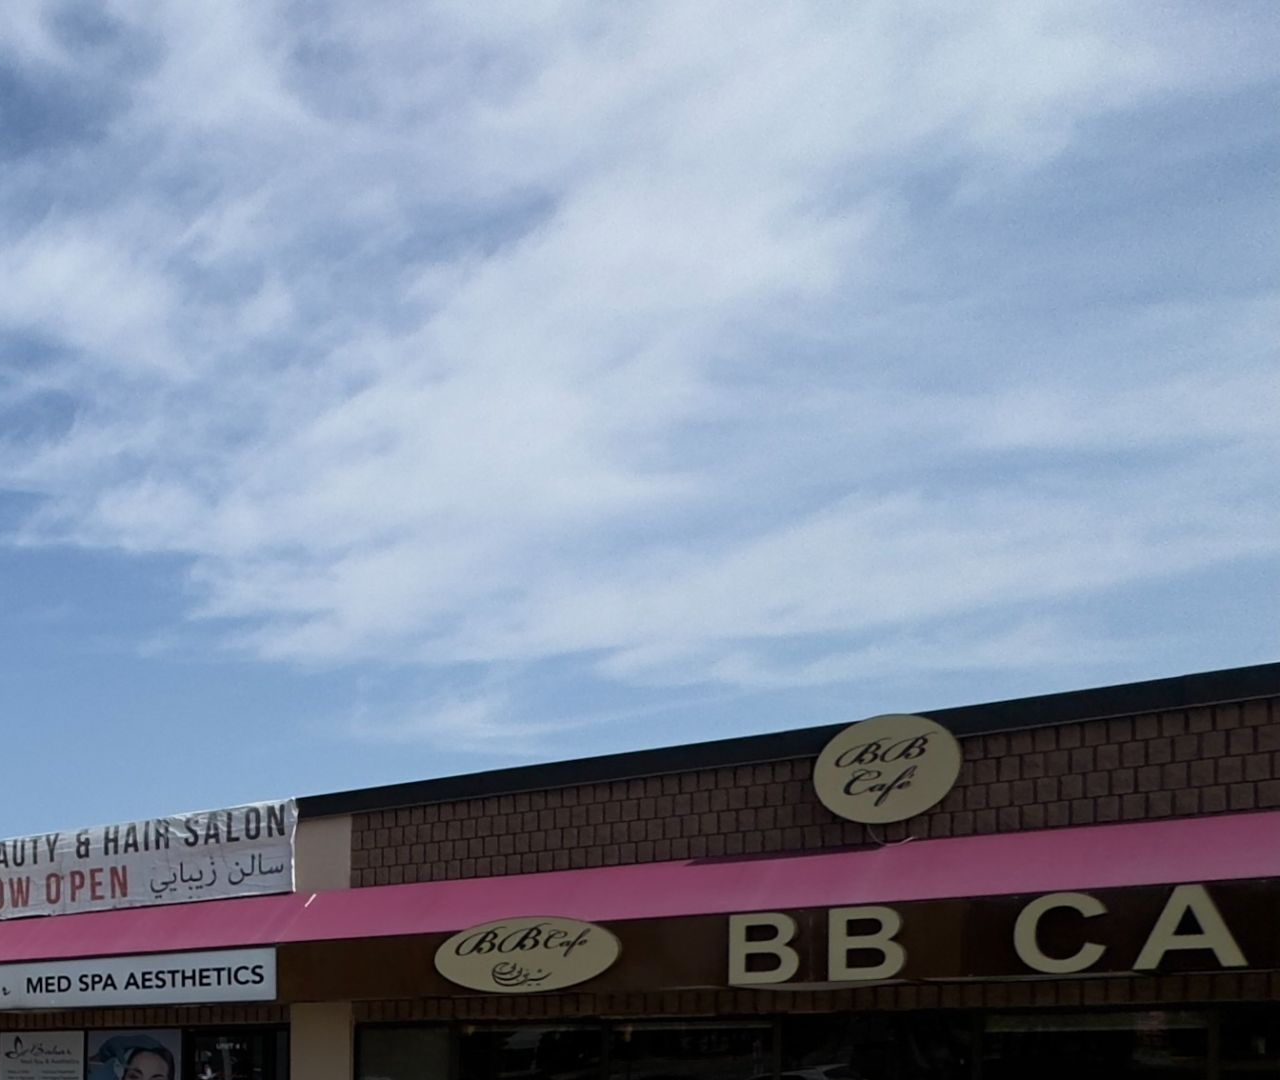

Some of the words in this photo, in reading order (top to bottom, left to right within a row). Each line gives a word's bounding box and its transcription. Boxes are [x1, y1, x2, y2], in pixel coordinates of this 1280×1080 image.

[834, 731, 937, 768] BB
[76, 837, 91, 859] &
[103, 818, 170, 857] HAIR
[184, 804, 286, 848] SALON
[45, 865, 129, 905] OPEN
[455, 923, 552, 957] BB
[728, 906, 906, 985] BB
[1013, 884, 1249, 974] CA
[26, 976, 72, 994] MED
[79, 973, 117, 993] SPA
[124, 965, 265, 991] AESTHETICS
